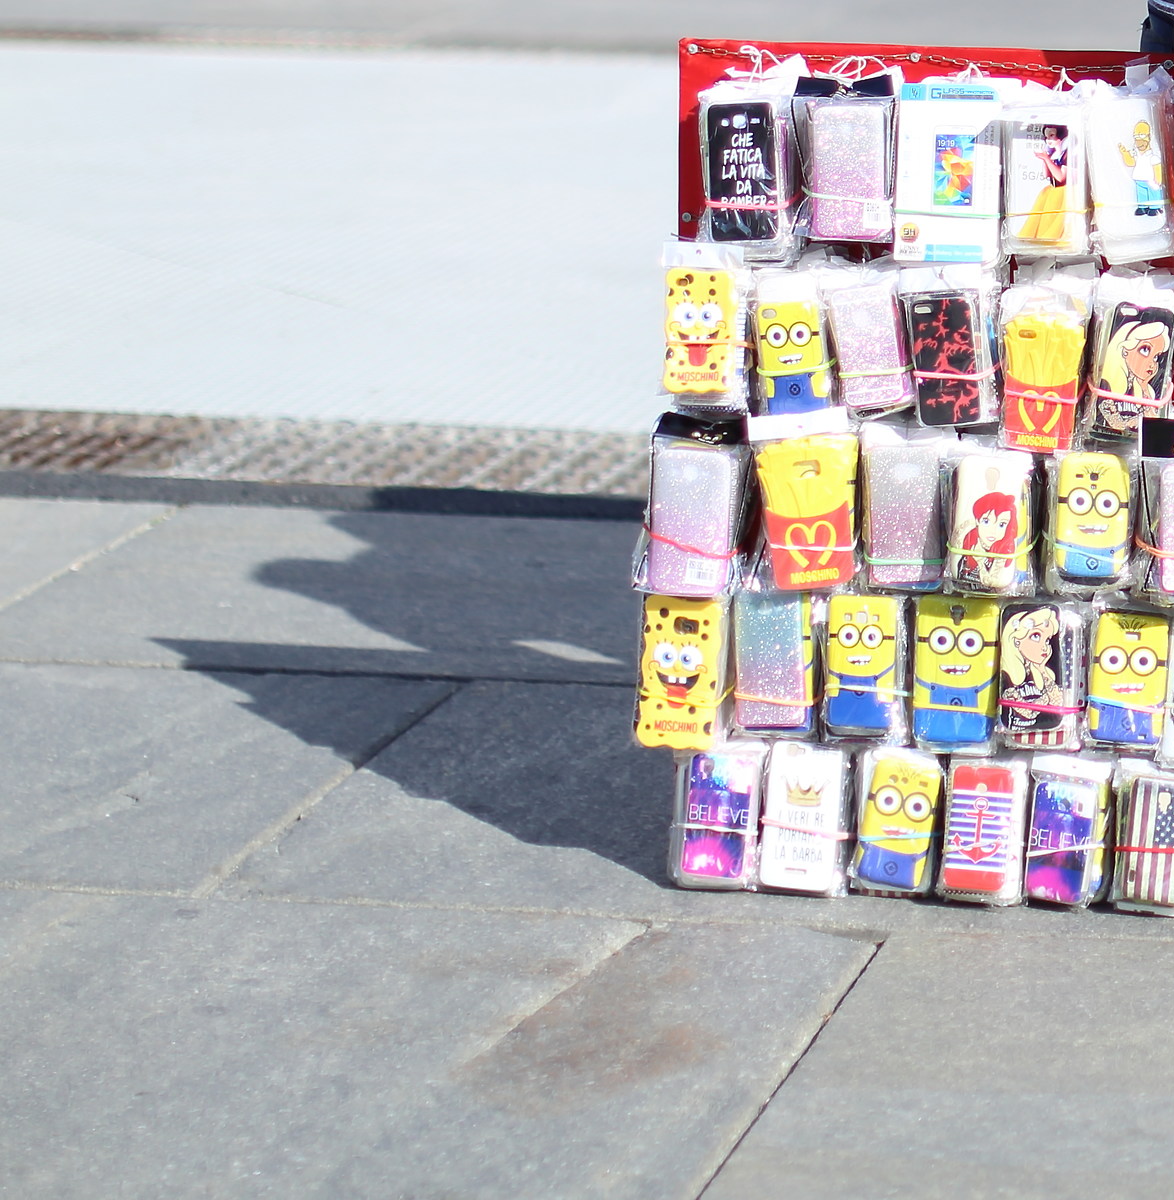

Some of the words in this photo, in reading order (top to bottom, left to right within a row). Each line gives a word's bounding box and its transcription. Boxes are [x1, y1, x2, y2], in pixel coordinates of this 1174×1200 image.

[731, 132, 754, 148] CHE
[723, 147, 763, 166] FATICA
[721, 164, 738, 181] LA
[740, 163, 766, 180] VITA
[736, 179, 753, 196] DA
[677, 371, 719, 383] MOSCHINO
[1016, 434, 1058, 449] MOSCHINO
[790, 567, 840, 585] MOSCHINO
[654, 719, 698, 734] MOSCHINO
[688, 803, 750, 827] BELIEVE
